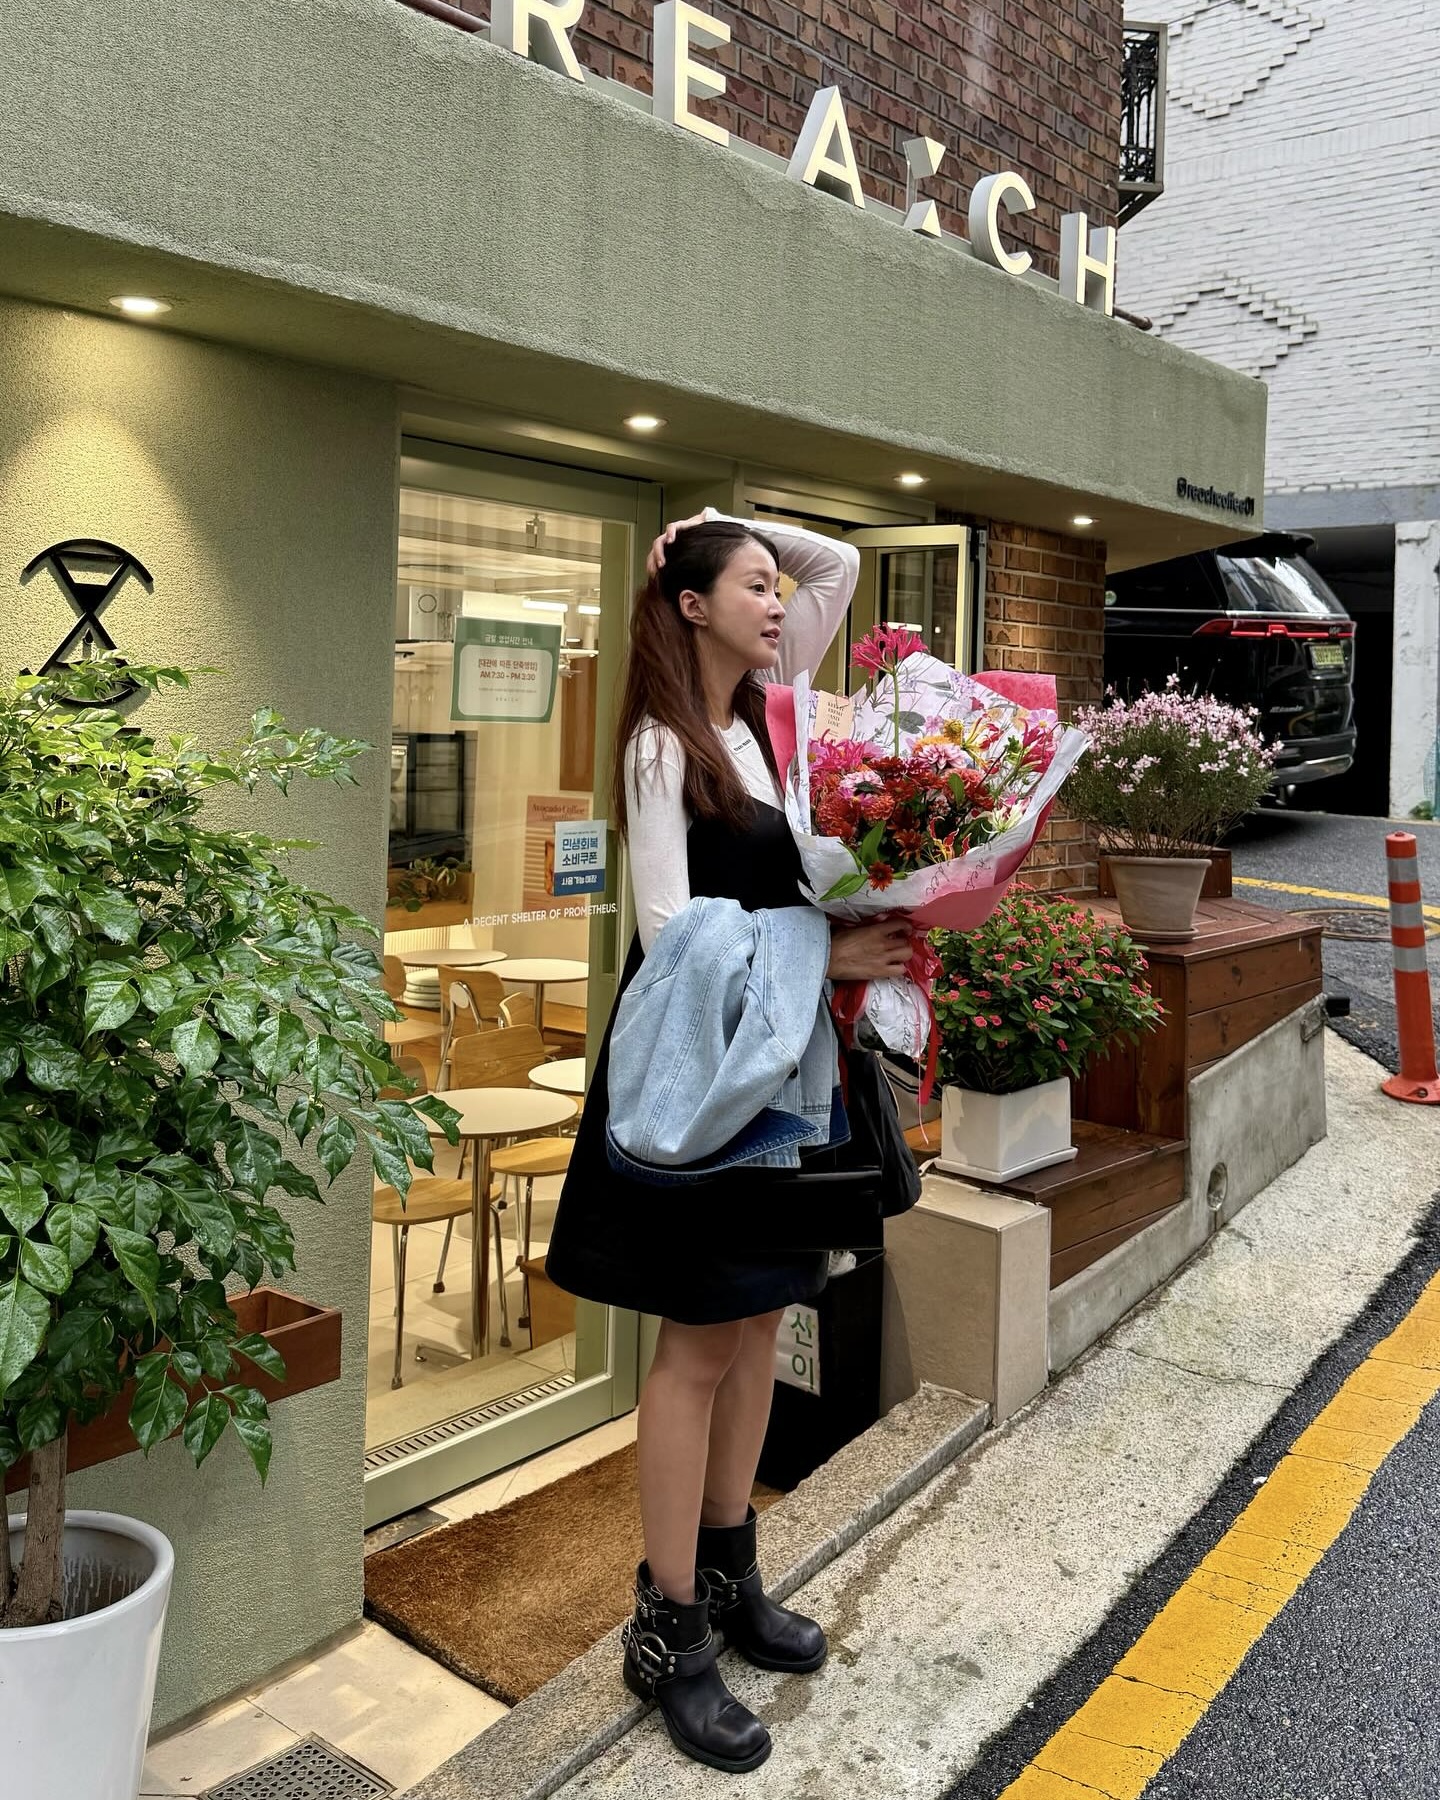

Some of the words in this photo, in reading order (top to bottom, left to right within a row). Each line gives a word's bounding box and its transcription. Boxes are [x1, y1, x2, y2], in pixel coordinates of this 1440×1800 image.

[562, 837, 598, 851] 민생회복
[562, 851, 597, 866] 소비쿠폰
[561, 876, 574, 886] 사용
[463, 918, 470, 928] A
[473, 914, 508, 926] DECENT
[511, 910, 547, 924] SHELTER
[549, 908, 561, 919] OF
[563, 902, 618, 917] PROMETHEUS.
